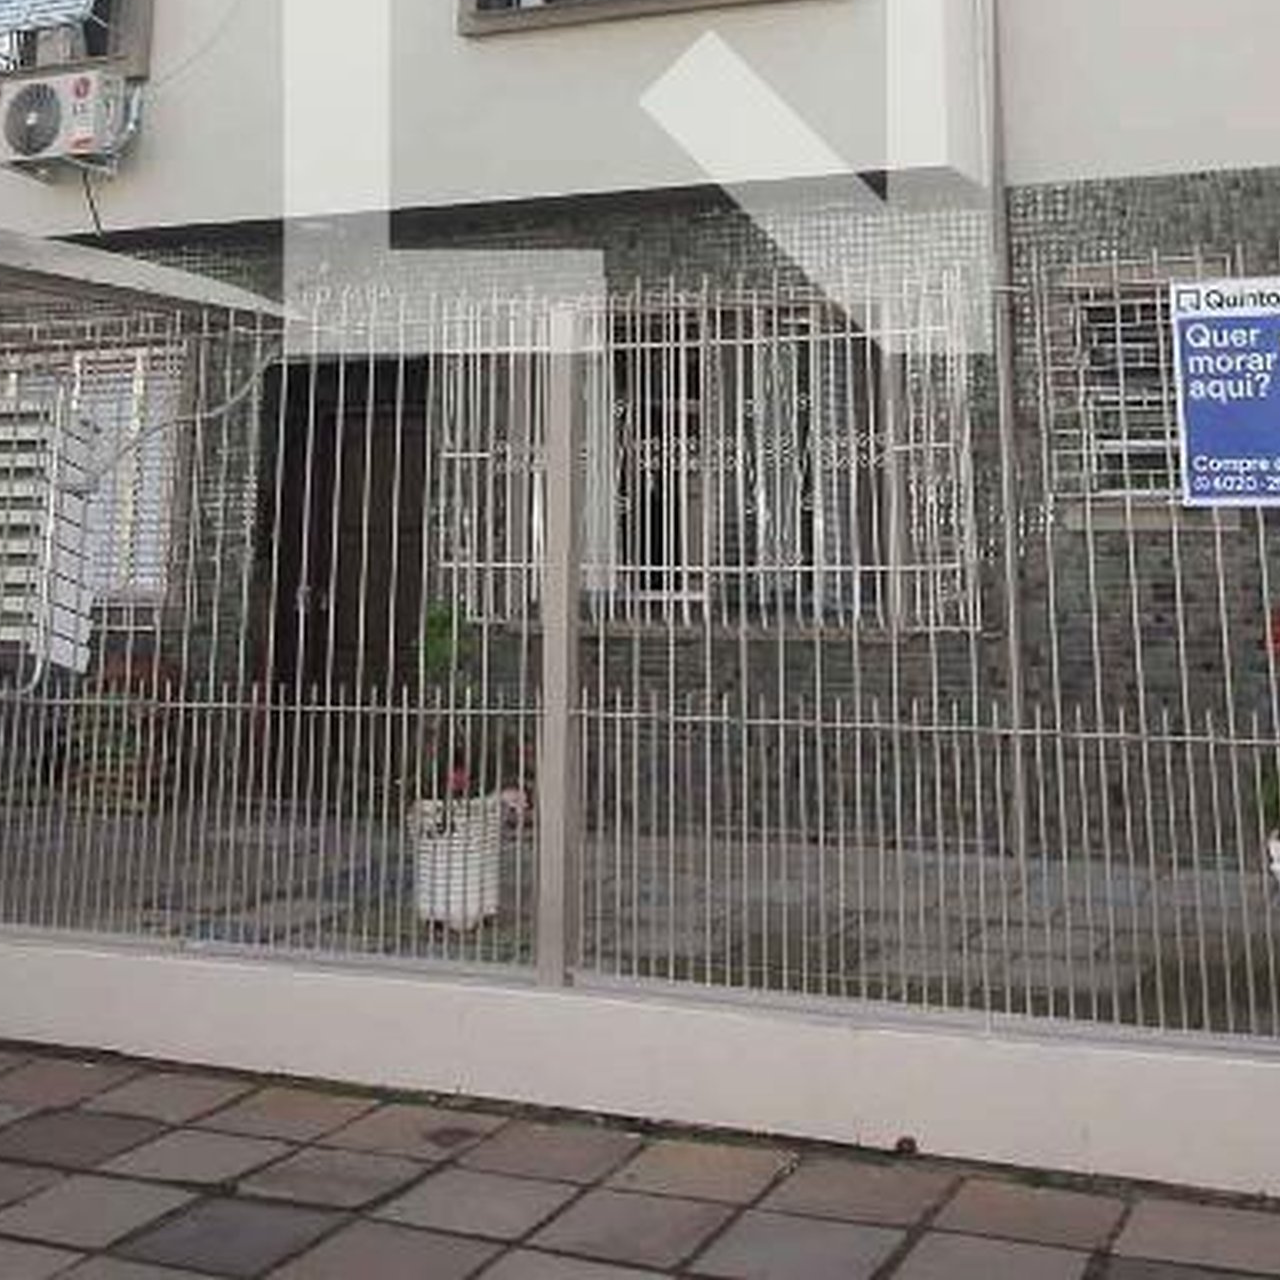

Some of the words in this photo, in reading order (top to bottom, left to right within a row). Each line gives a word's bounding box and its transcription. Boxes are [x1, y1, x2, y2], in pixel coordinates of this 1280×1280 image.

[1186, 324, 1262, 349] Quer
[1188, 350, 1277, 375] morar
[1188, 373, 1272, 404] aqui?
[1192, 455, 1270, 476] Compre
